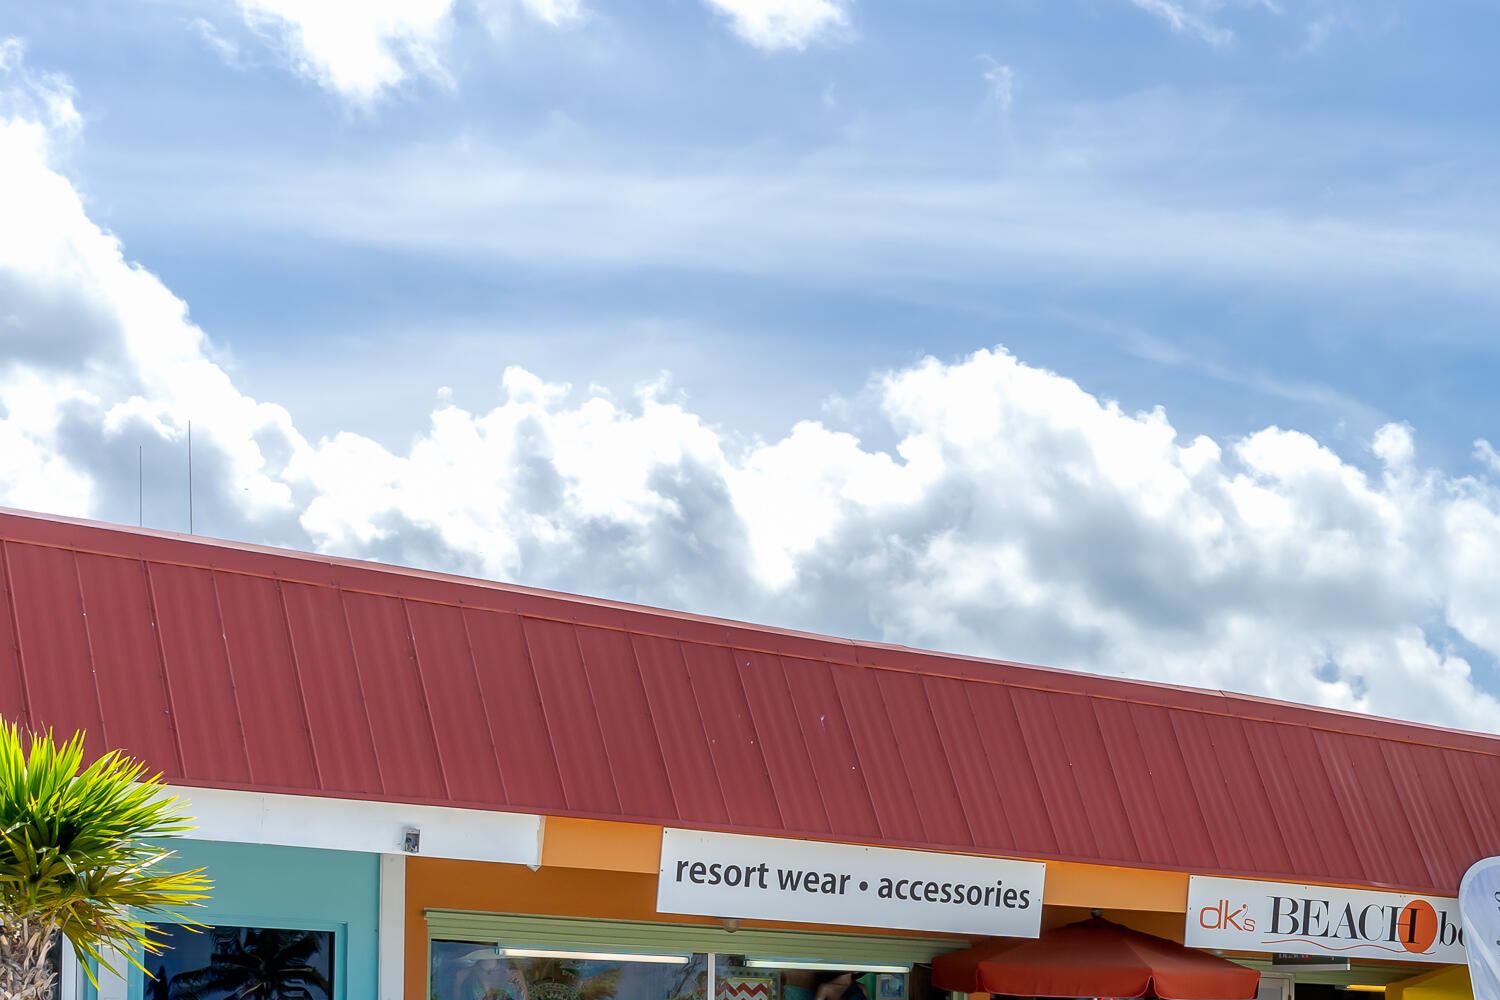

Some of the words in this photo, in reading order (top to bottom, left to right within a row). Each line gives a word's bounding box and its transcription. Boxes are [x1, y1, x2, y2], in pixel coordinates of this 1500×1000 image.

[676, 859, 769, 889] resort
[777, 868, 851, 896] wear
[878, 876, 1031, 910] accessories
[1264, 896, 1424, 943] BEACH
